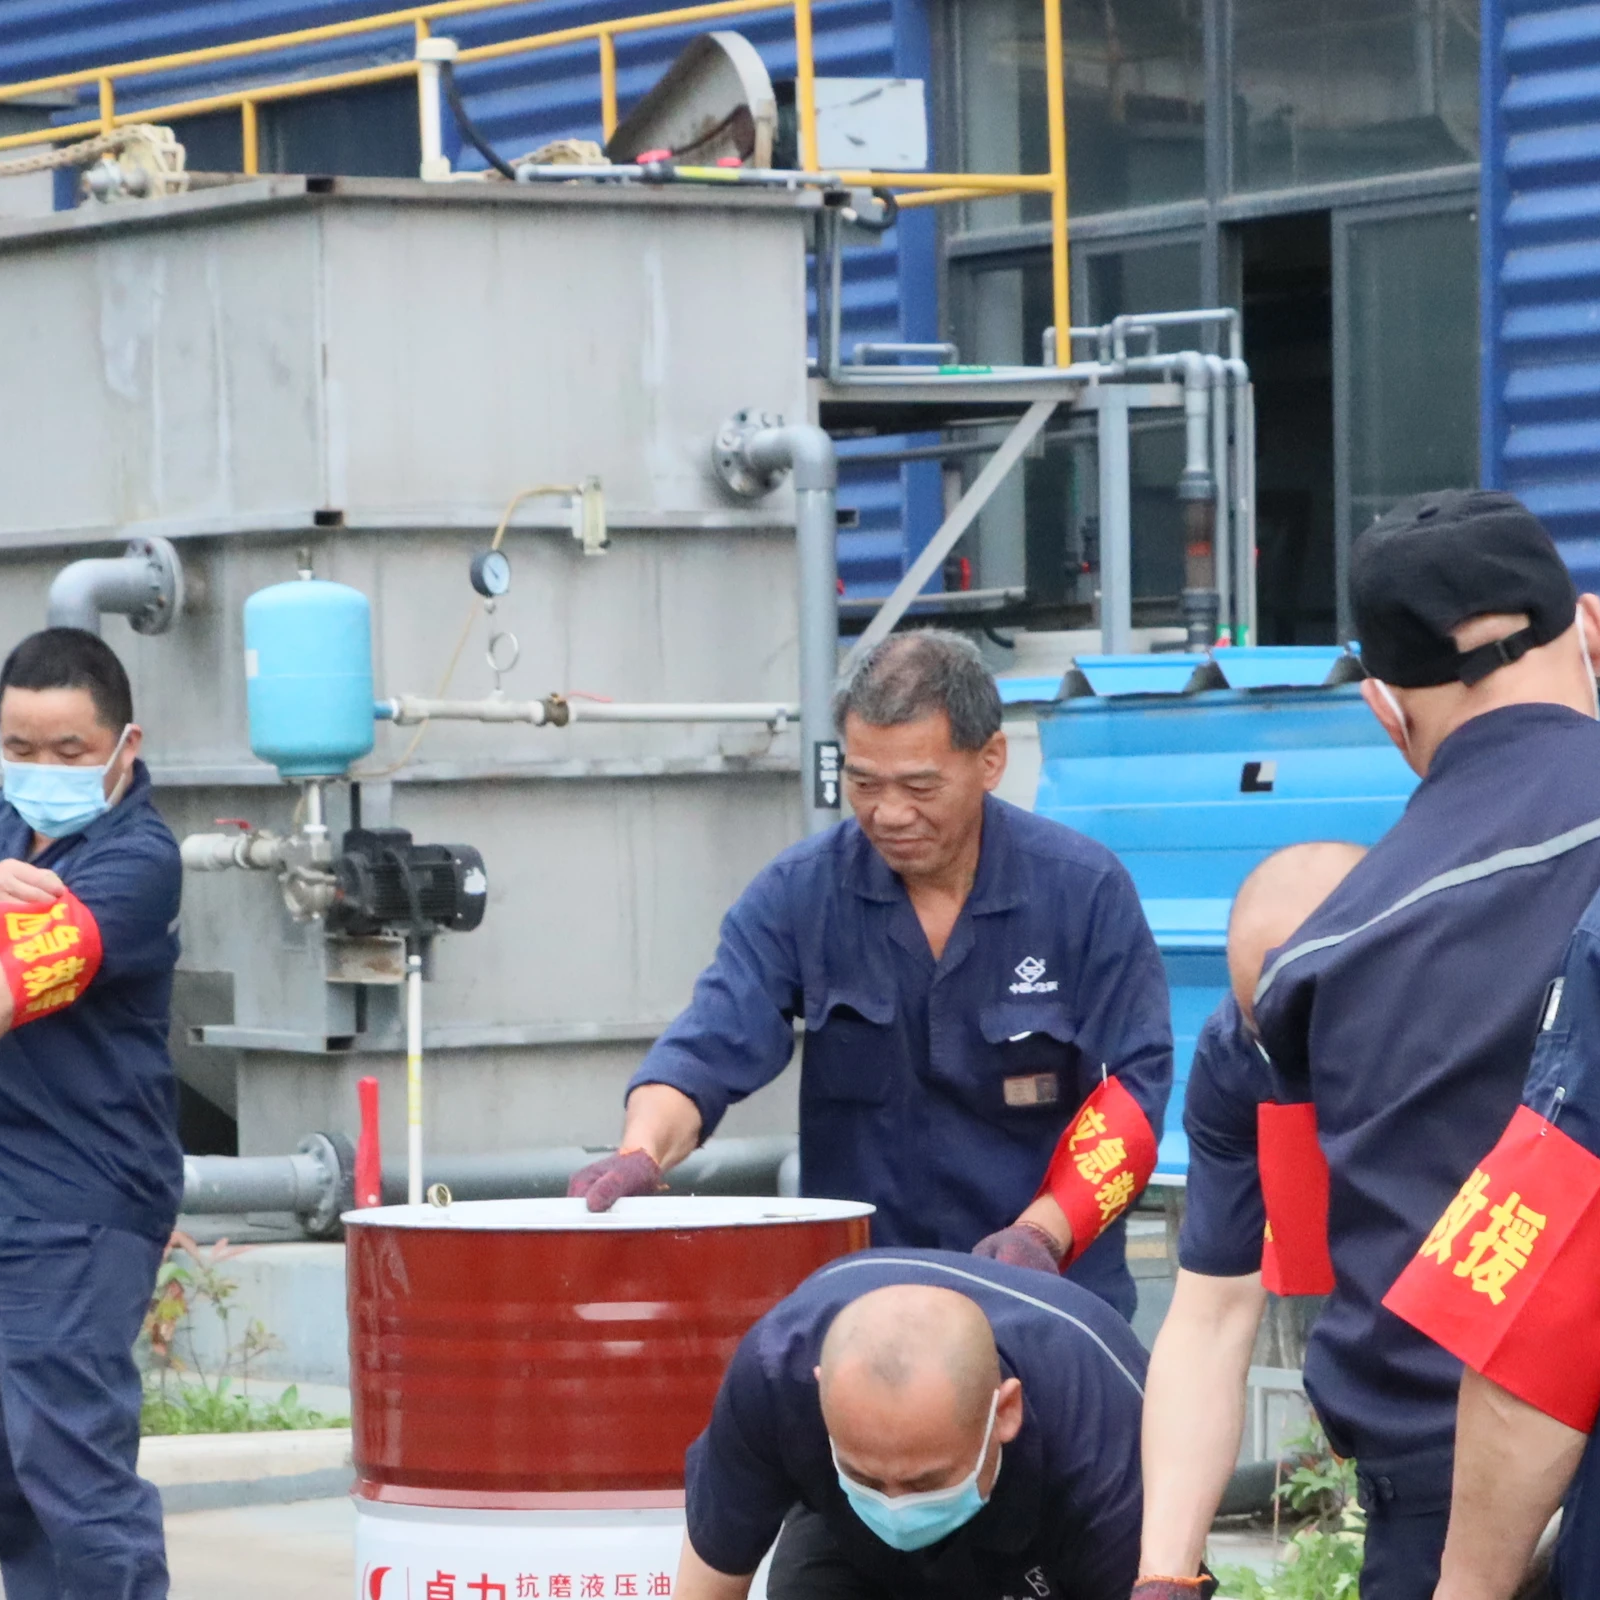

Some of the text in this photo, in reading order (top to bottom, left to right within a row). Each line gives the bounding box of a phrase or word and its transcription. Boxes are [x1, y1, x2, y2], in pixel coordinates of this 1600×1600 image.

[1069, 1106, 1136, 1232] 应急救
[515, 1571, 672, 1599] 抗磨液压油
